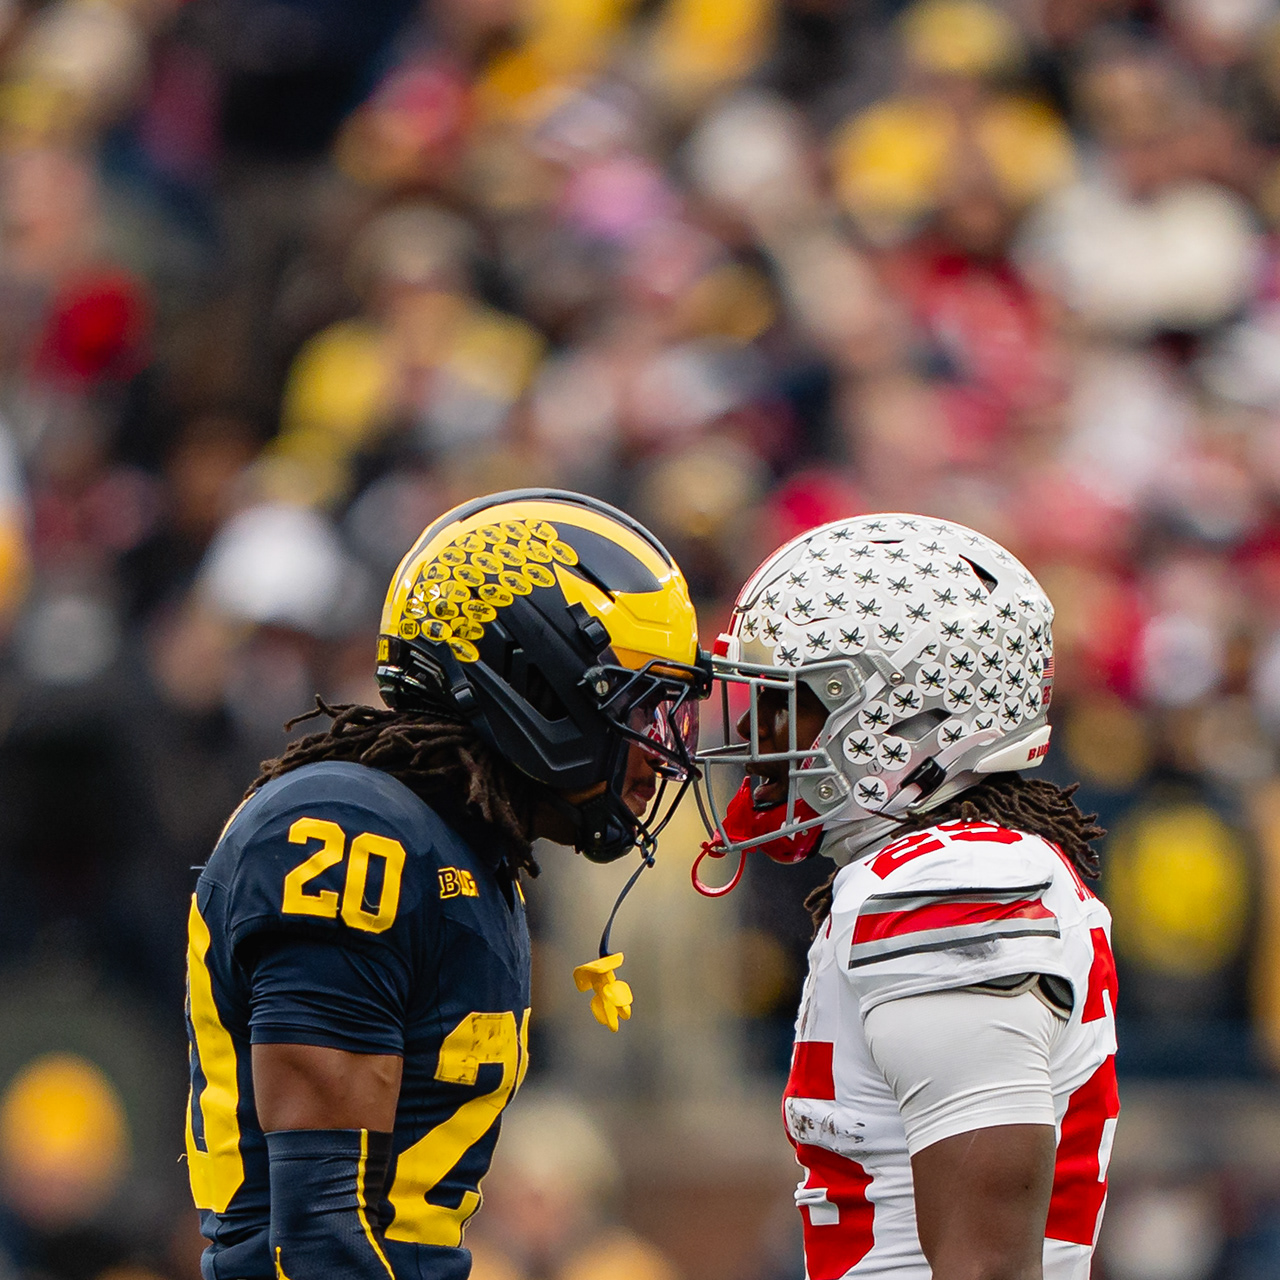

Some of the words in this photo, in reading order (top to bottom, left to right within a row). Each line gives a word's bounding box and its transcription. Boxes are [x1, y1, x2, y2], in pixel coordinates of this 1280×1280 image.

[282, 817, 406, 934] 20
[186, 892, 245, 1214] 0
[384, 1006, 531, 1247] 2
